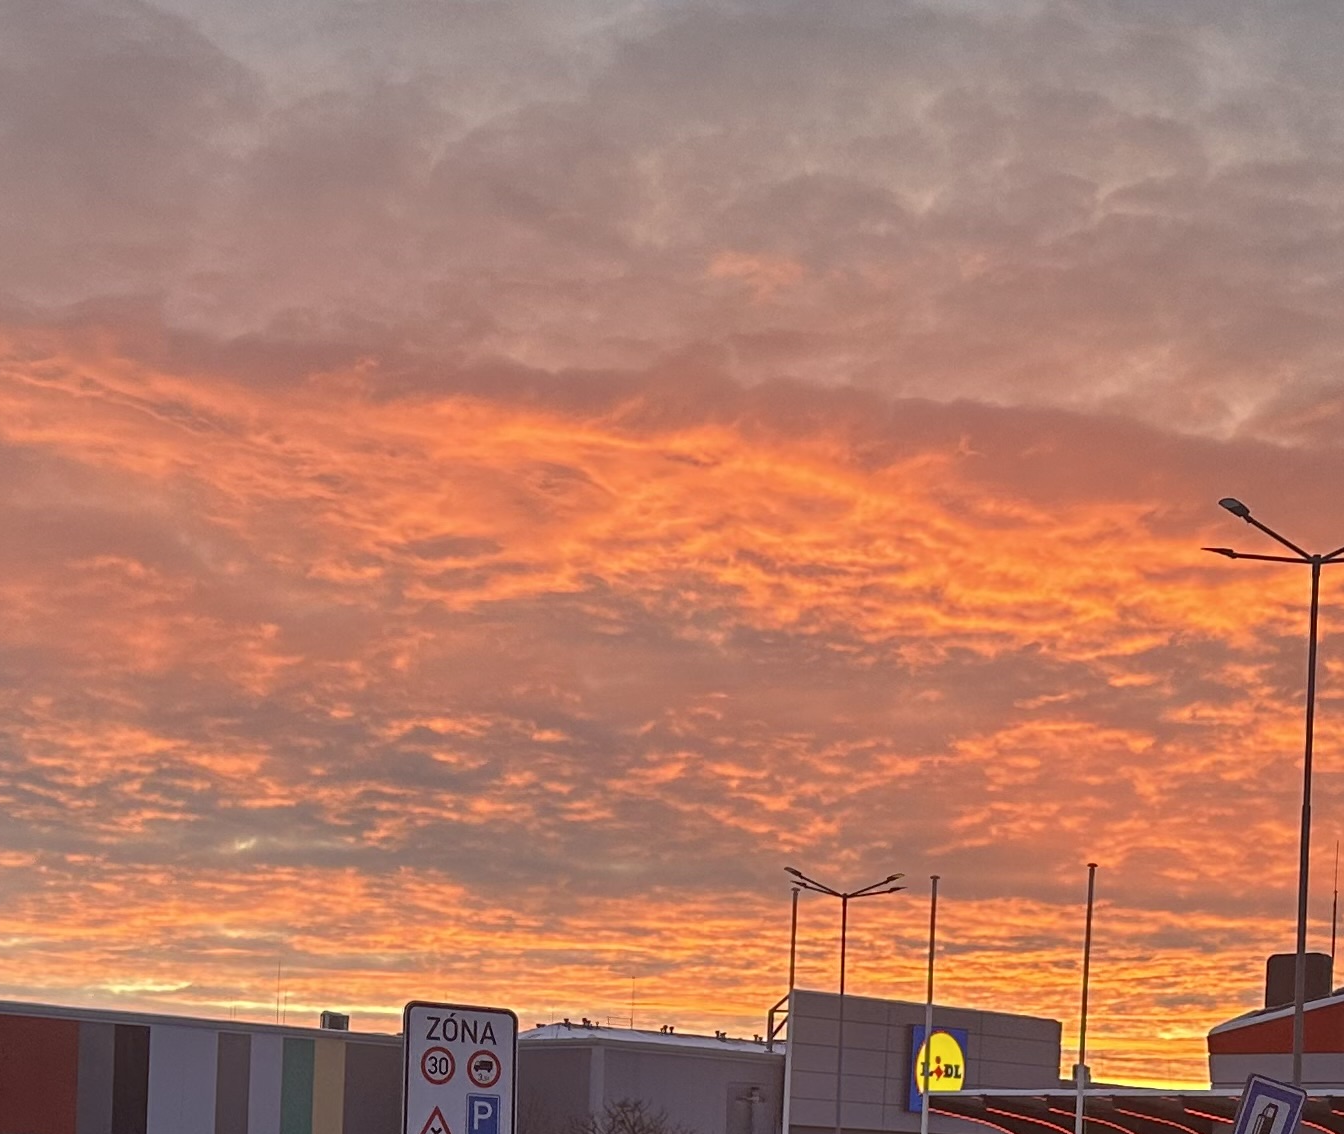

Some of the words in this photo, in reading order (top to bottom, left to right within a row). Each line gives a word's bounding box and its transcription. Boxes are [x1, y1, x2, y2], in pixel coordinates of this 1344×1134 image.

[426, 1012, 497, 1046] ZÓNA
[427, 1056, 450, 1076] 30
[473, 1100, 493, 1130] P
